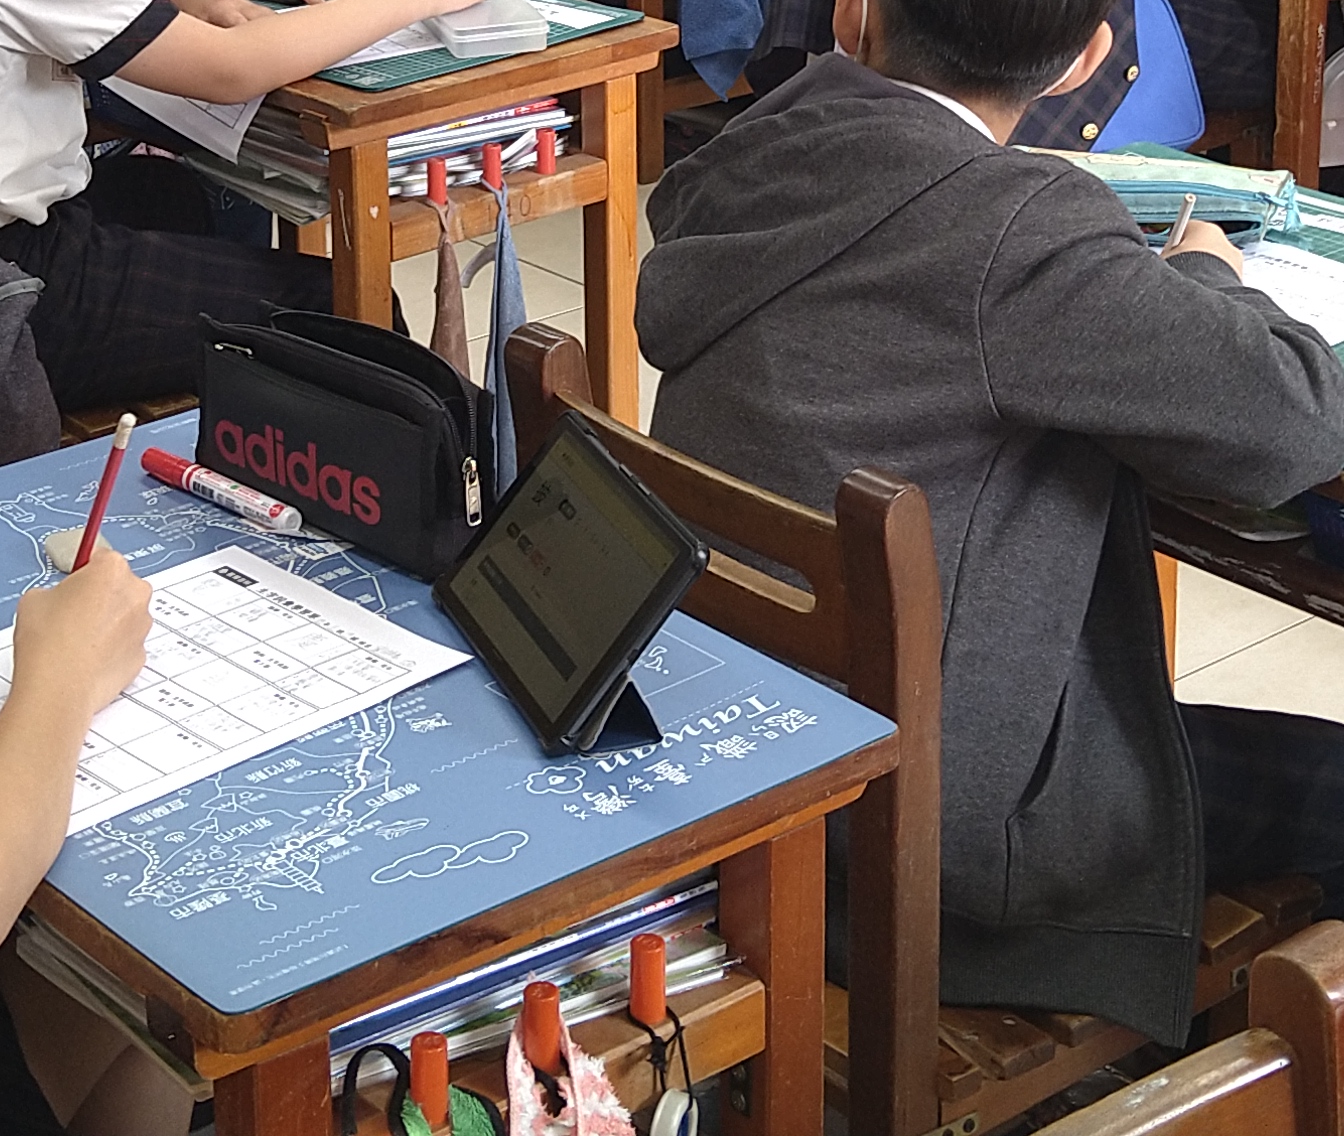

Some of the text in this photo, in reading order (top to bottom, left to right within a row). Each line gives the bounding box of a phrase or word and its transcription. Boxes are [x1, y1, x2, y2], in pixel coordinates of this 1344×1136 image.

[214, 420, 381, 525] adidas
[594, 694, 780, 773] Taiwan
[245, 757, 303, 784] 新竹縣
[583, 709, 817, 816] 認識臺灣
[365, 783, 421, 808] 桃園市
[129, 798, 189, 826] 宜蘭縣
[214, 817, 273, 844] 新北市
[290, 835, 349, 862] 臺北市
[169, 891, 231, 921] 基隆市
